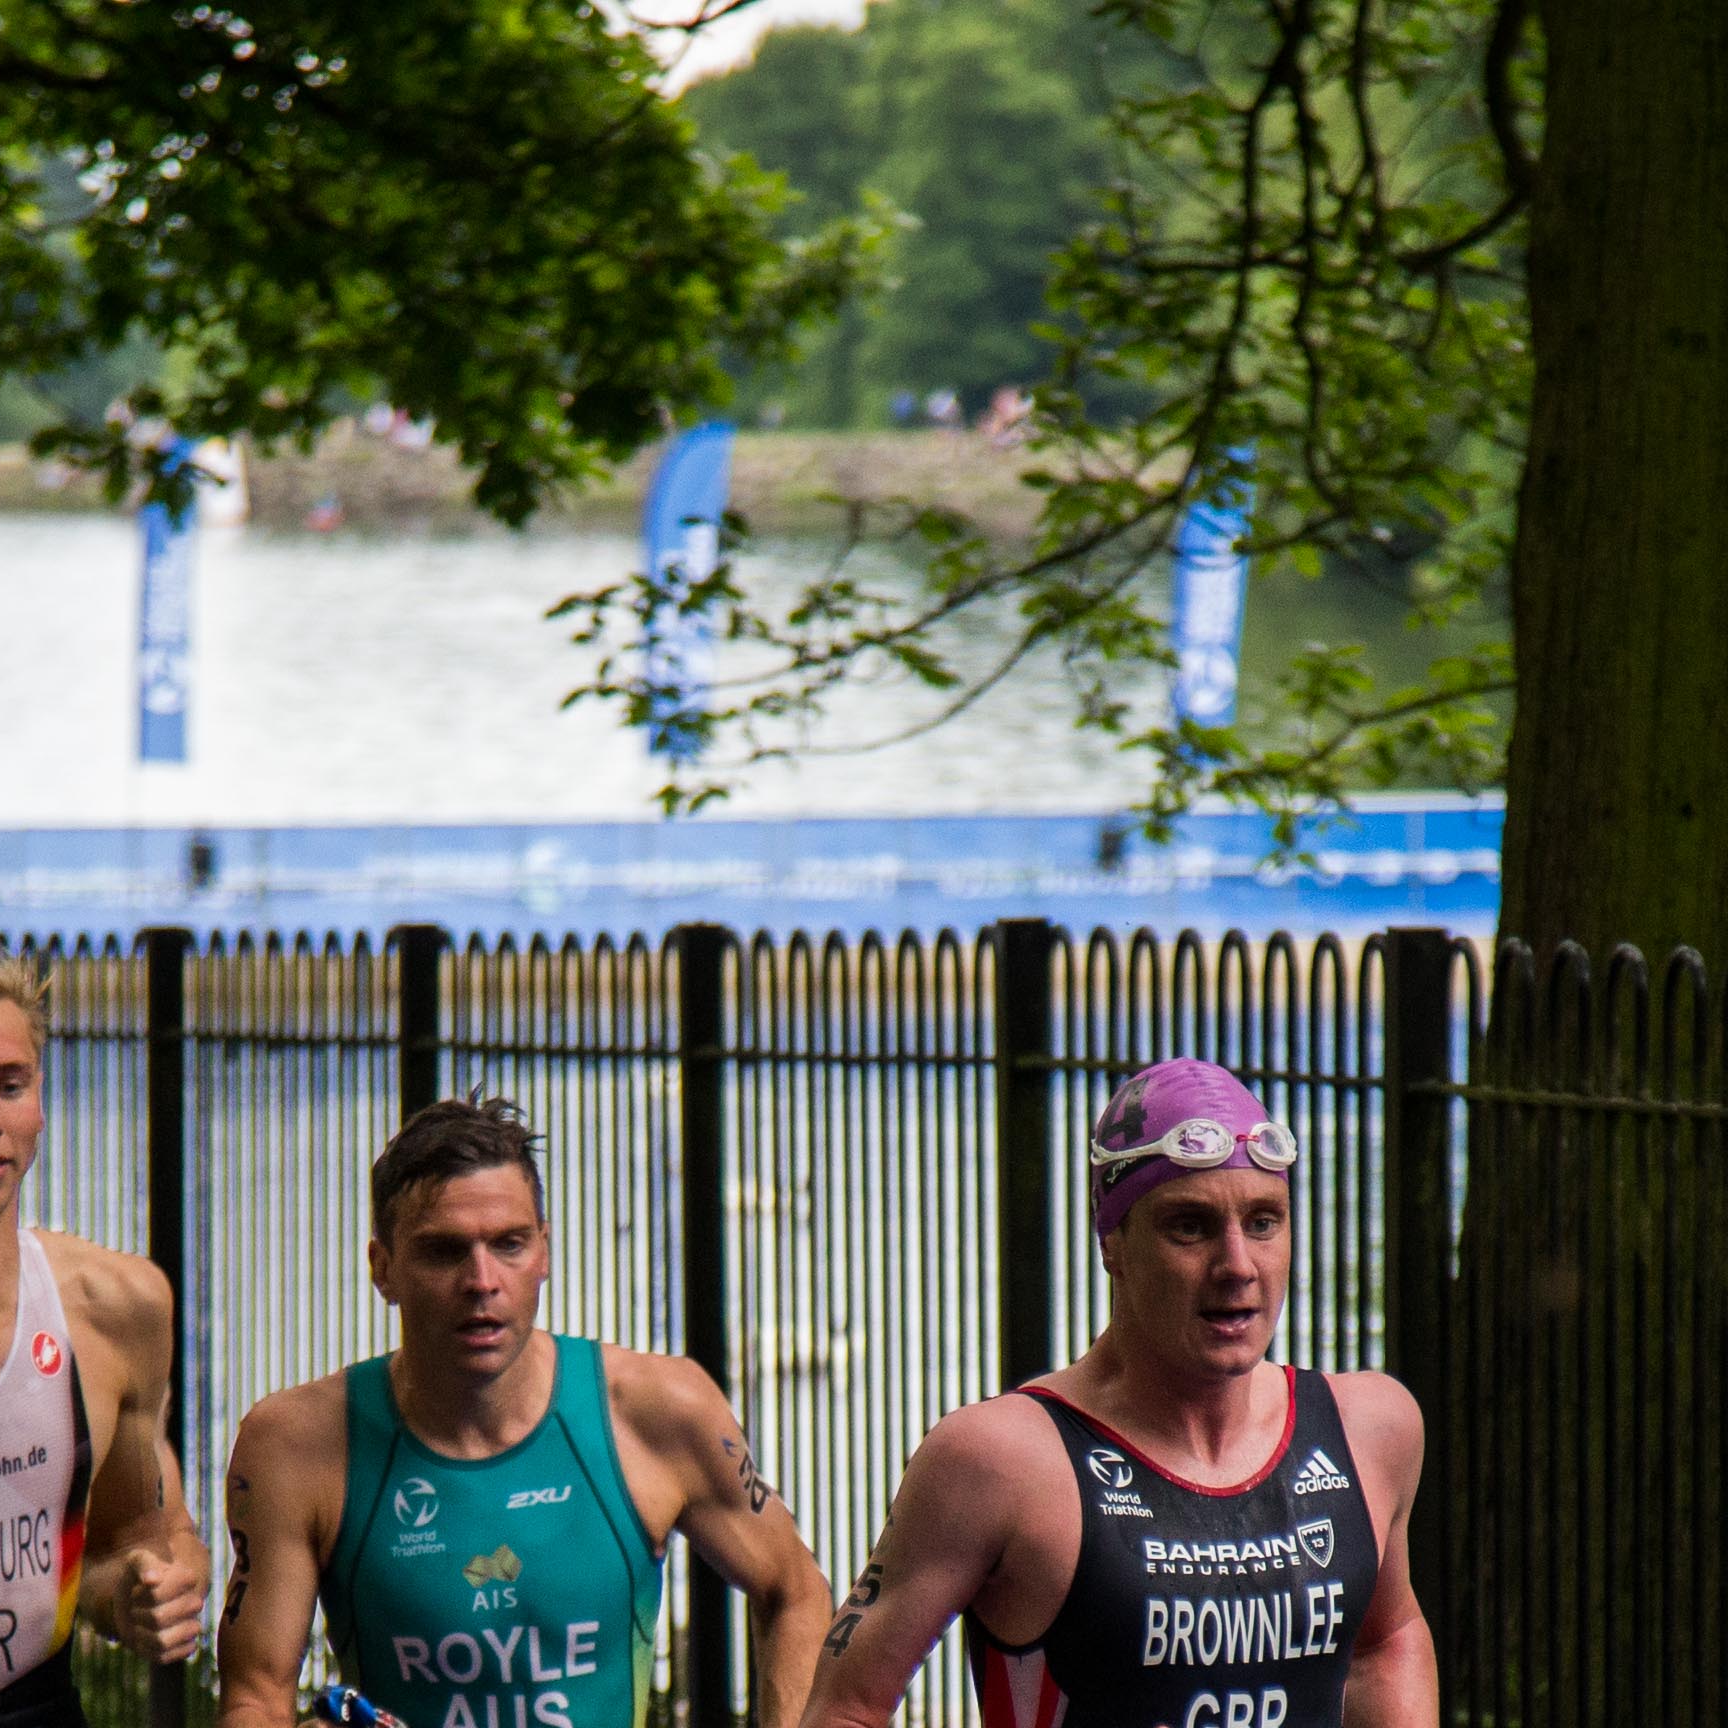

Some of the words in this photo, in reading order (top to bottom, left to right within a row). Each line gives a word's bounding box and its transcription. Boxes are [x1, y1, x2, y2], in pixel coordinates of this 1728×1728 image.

[1294, 1474, 1350, 1495] adidas
[506, 1485, 572, 1509] 2XU
[1104, 1492, 1142, 1505] World
[1099, 1504, 1154, 1518] Triathlon
[398, 1531, 437, 1544] World
[1144, 1535, 1298, 1562] BAHRAIN
[1146, 1555, 1302, 1576] ENDURANCE
[473, 1588, 518, 1612] AIS
[1143, 1582, 1345, 1667] BROWNLEE
[392, 1621, 600, 1685] ROYLE
